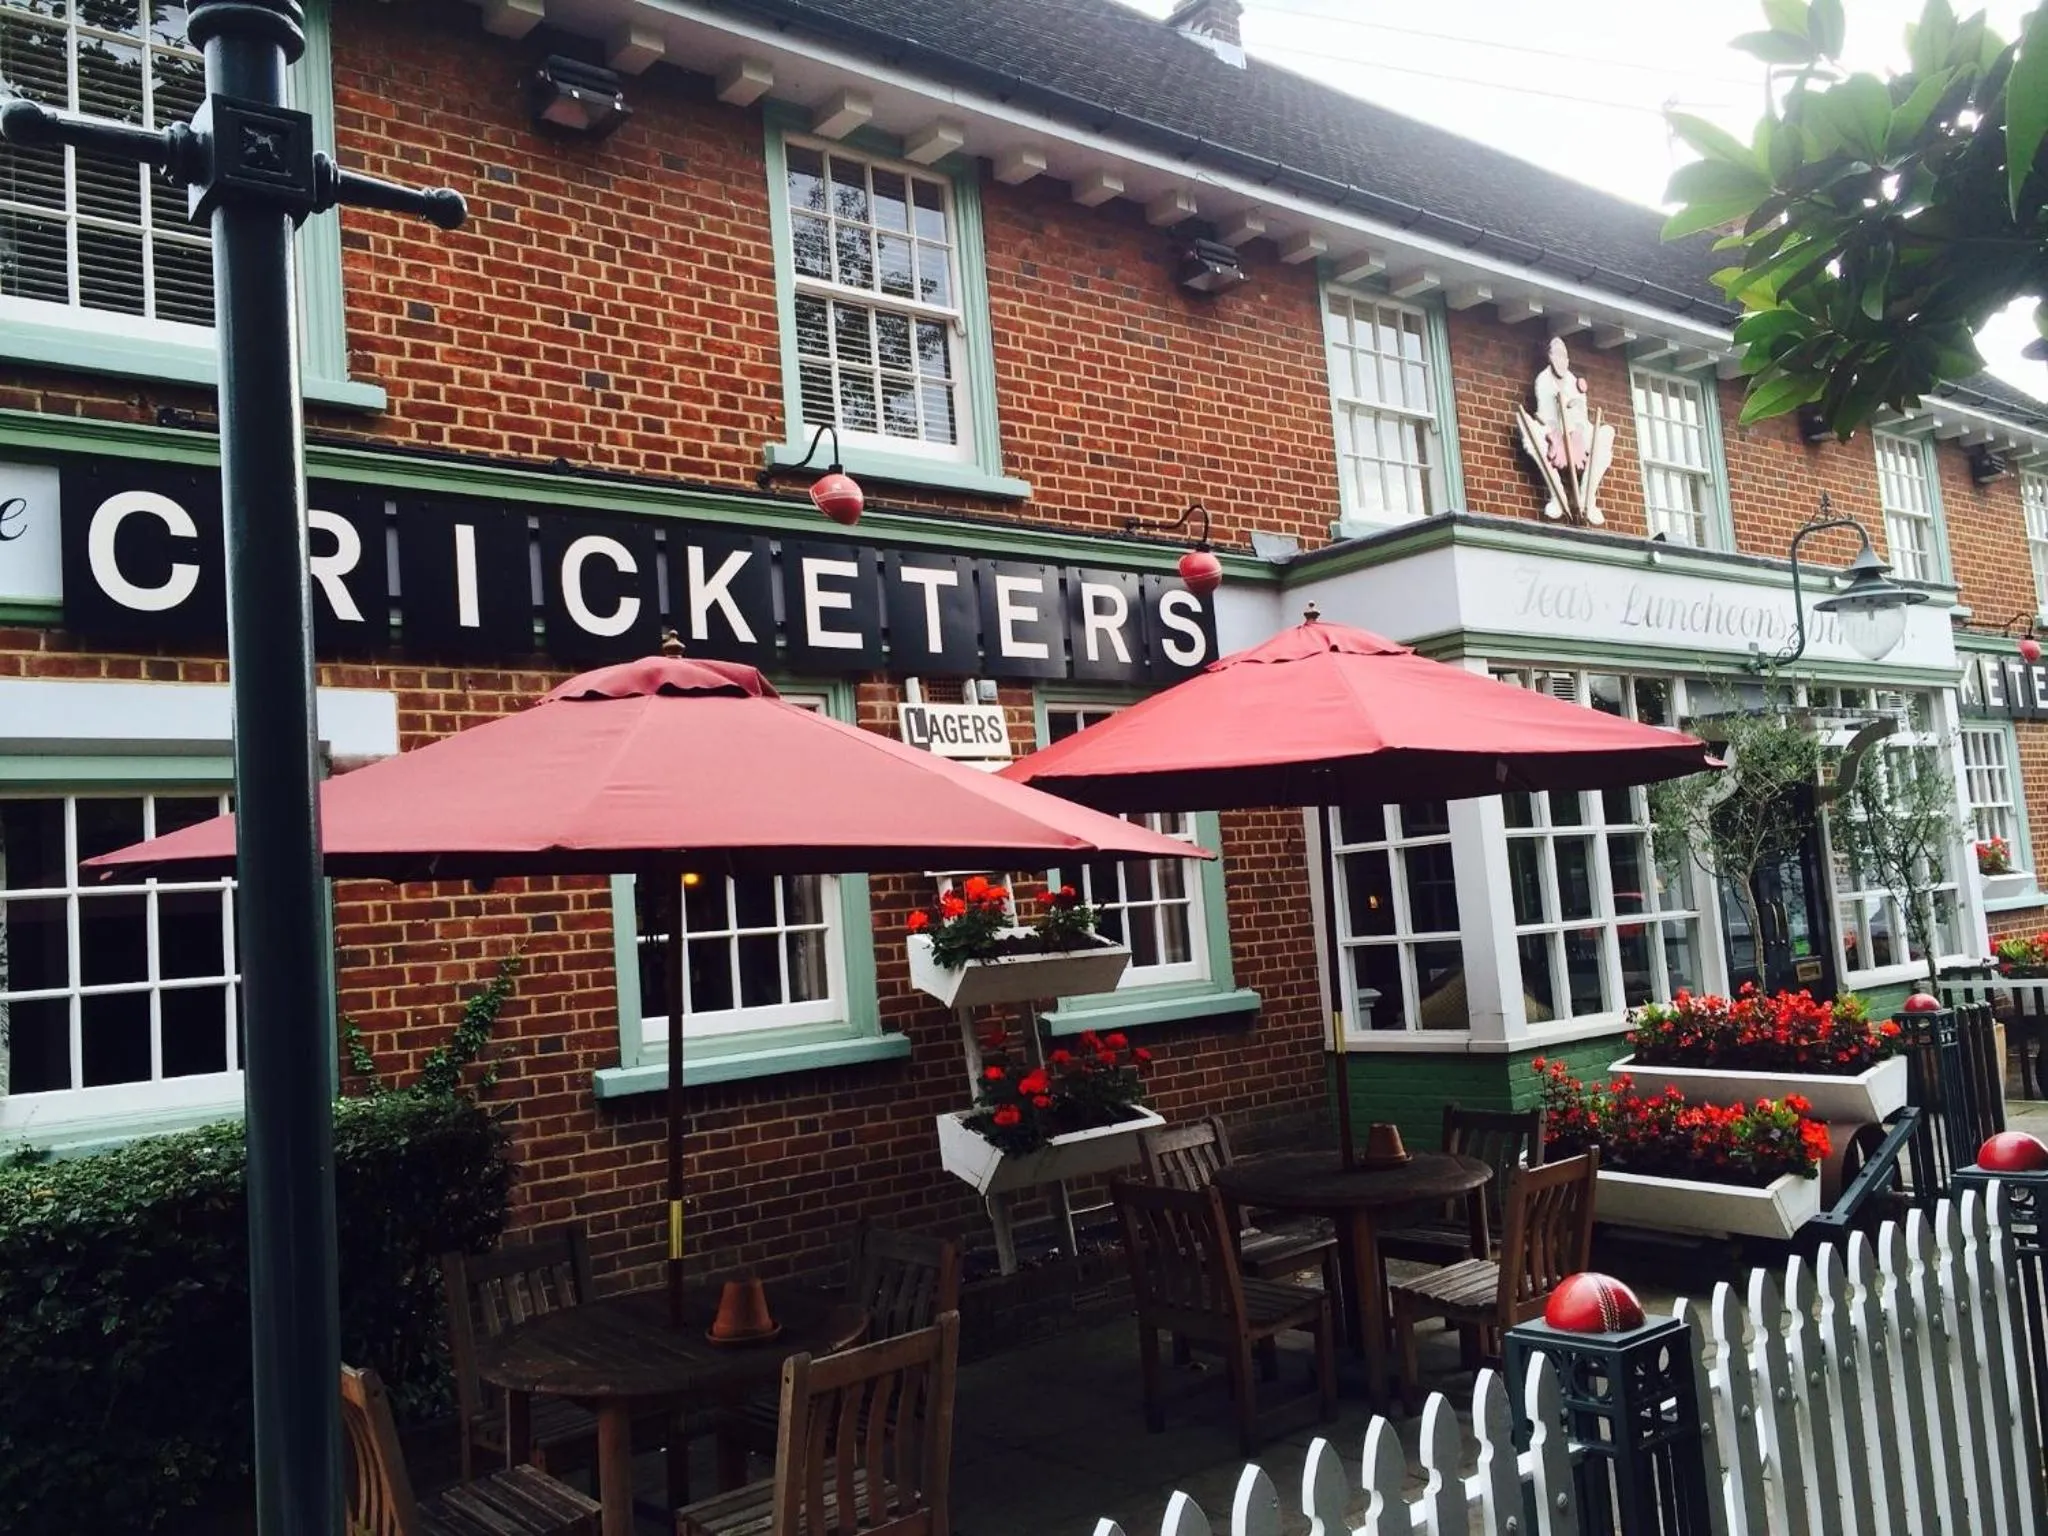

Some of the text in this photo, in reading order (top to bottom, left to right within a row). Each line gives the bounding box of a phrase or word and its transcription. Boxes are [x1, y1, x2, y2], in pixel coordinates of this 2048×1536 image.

[87, 489, 1208, 668] CRICKETERS
[1514, 567, 1594, 623] Teas
[905, 708, 1003, 747] LAGERS
